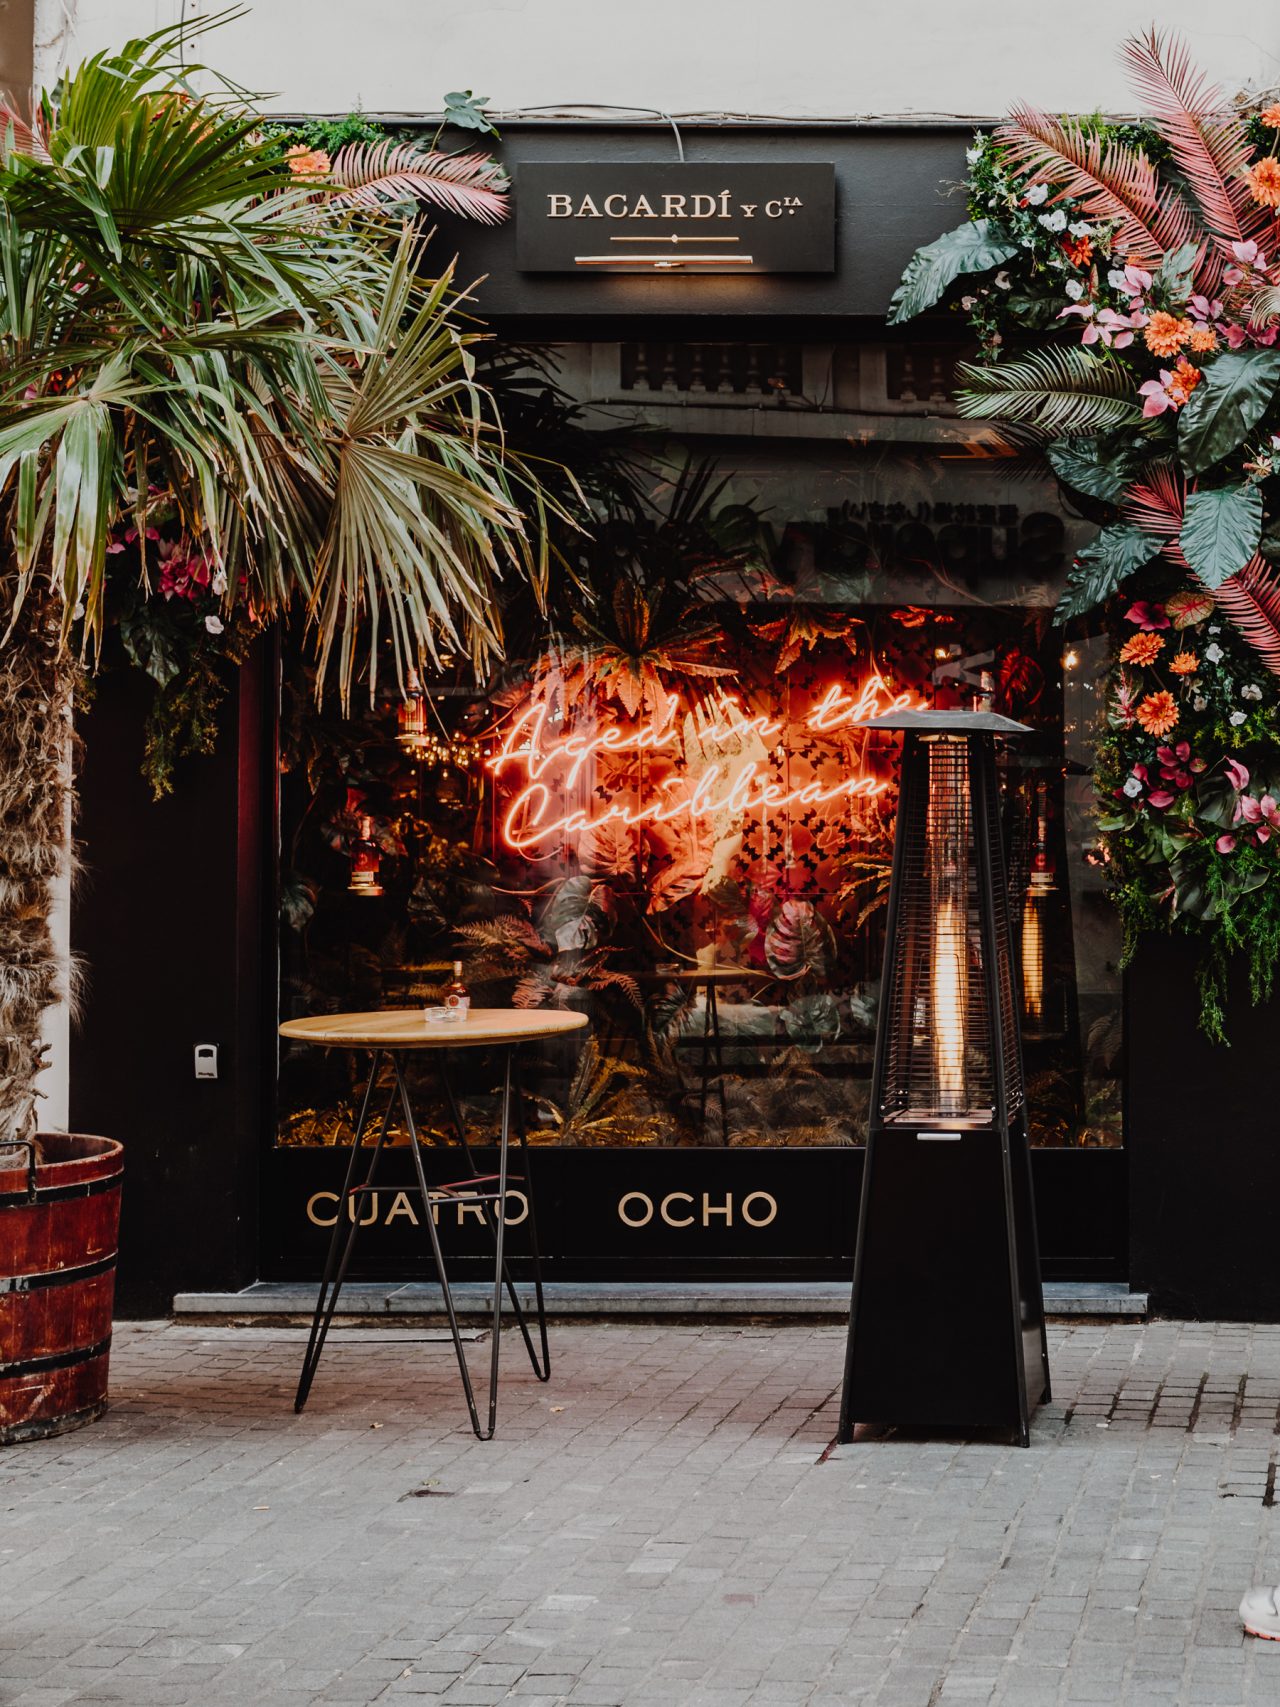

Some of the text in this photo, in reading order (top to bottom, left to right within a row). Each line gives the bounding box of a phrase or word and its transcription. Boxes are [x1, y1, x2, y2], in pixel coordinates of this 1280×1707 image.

[546, 189, 732, 218] BACARDÍ
[740, 204, 758, 218] Y
[486, 674, 931, 789] Aged in the
[503, 760, 889, 849] Caribbean
[617, 1191, 778, 1227] OCHO
